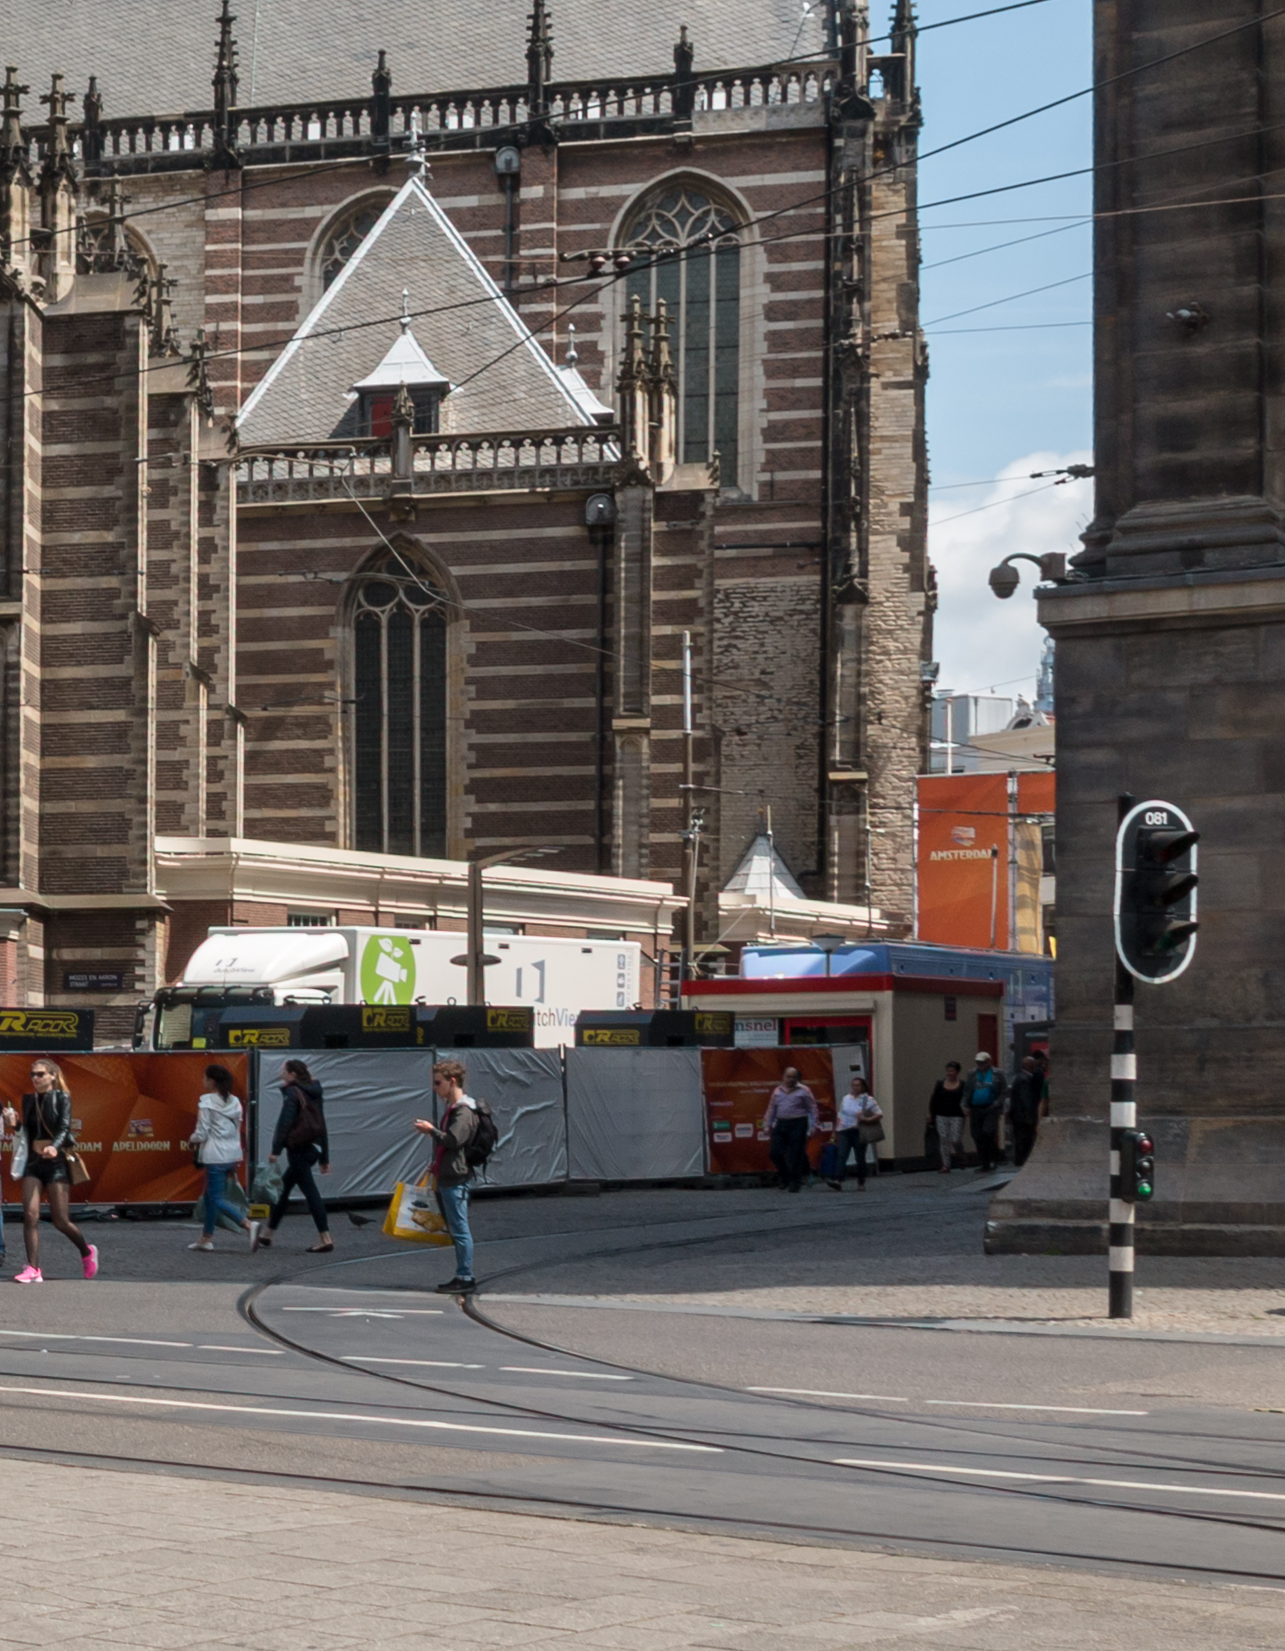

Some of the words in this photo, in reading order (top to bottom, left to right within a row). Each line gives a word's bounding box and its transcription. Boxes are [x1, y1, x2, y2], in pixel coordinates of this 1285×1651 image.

[1145, 811, 1167, 825] 081
[534, 1007, 579, 1027] tchVie
[735, 1018, 778, 1032] nsnel
[73, 1142, 102, 1152] RDAM
[112, 1141, 170, 1152] APELDOORN
